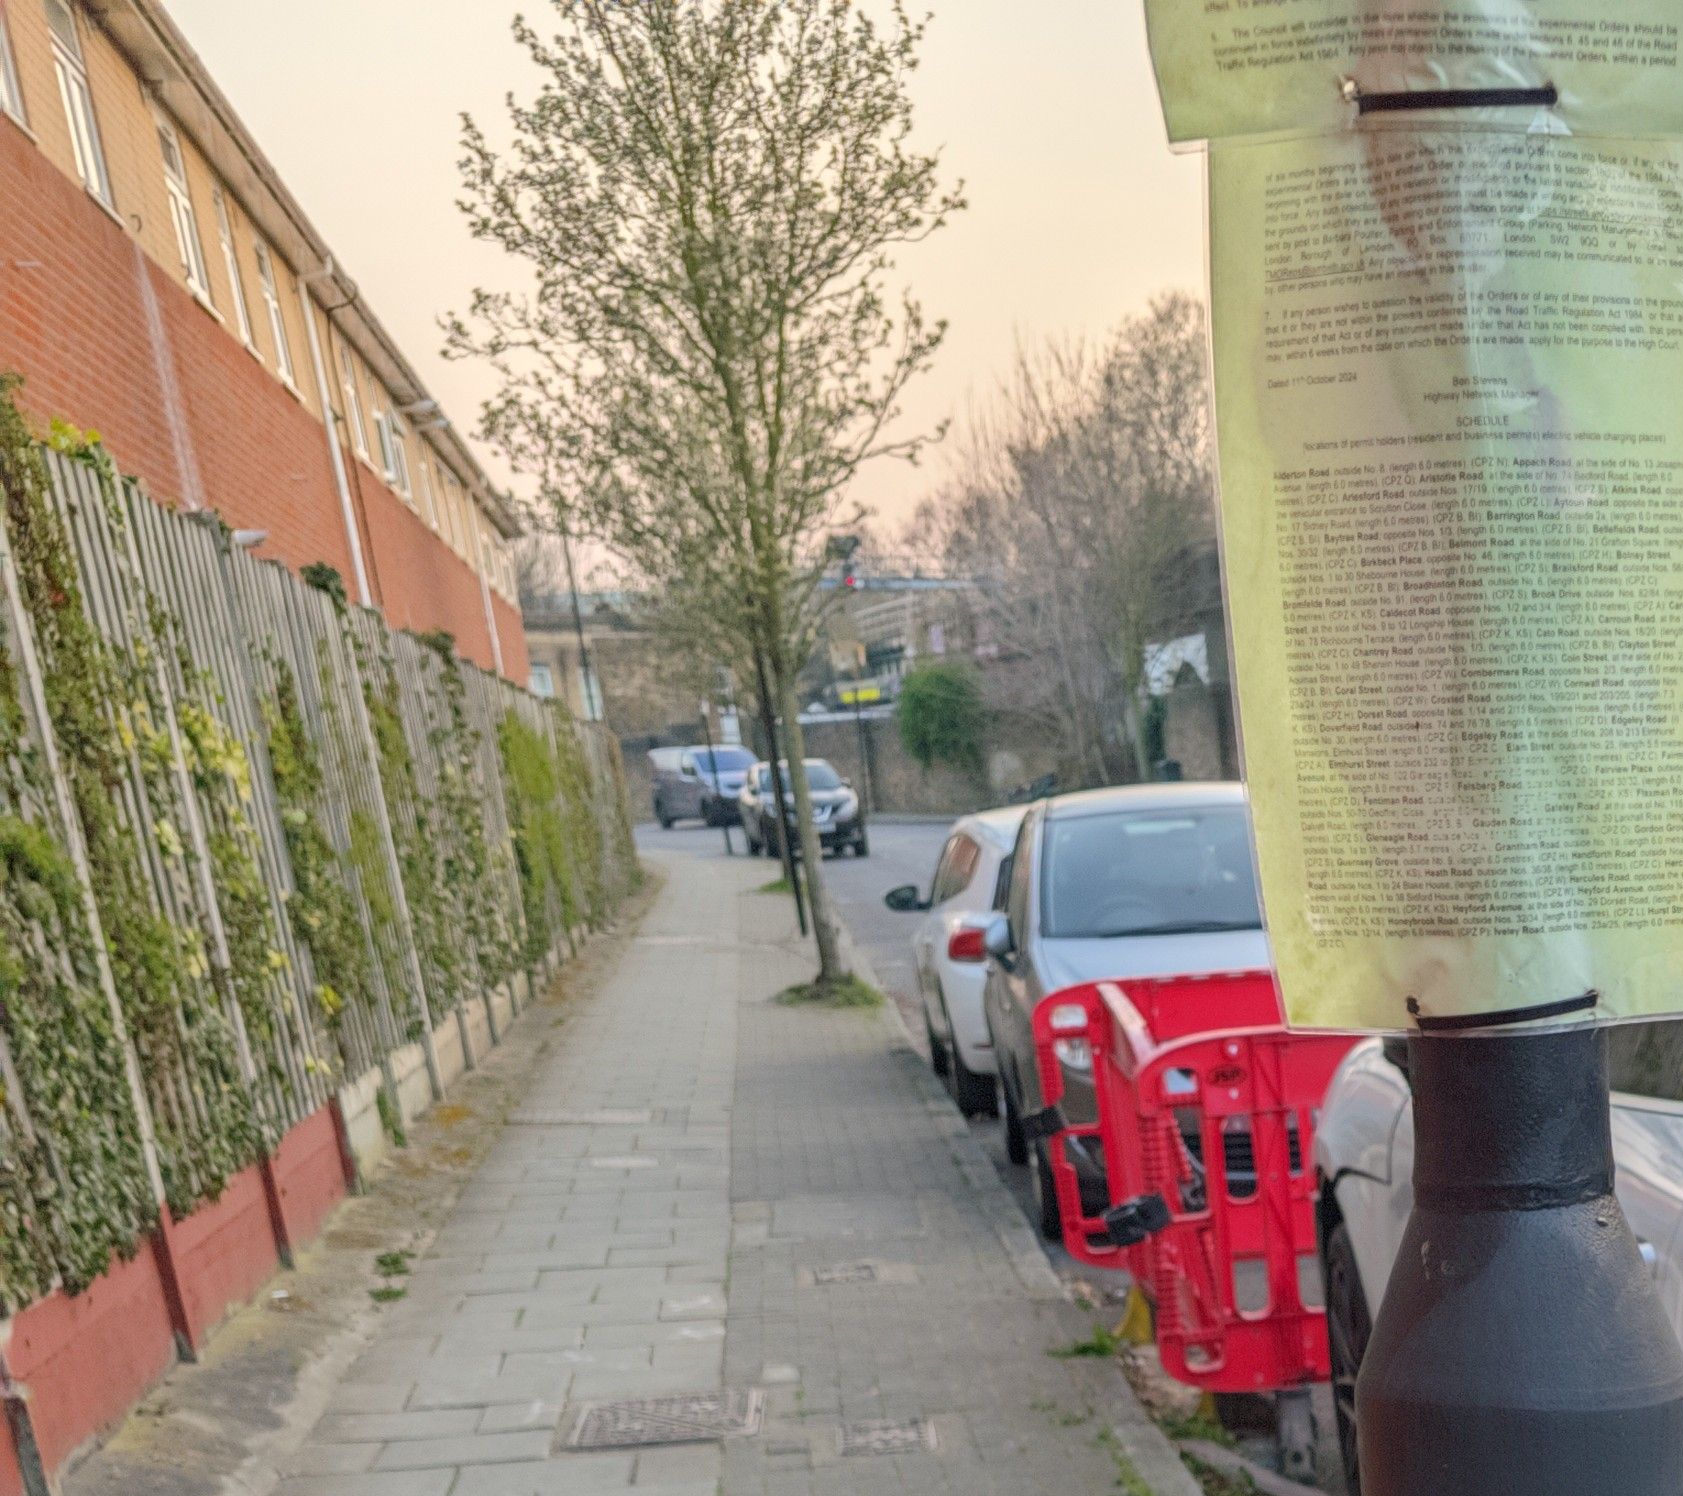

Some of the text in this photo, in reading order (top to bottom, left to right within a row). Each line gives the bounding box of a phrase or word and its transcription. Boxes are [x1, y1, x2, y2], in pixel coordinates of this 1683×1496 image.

[1600, 21, 1630, 32] Orders
[1654, 41, 1678, 50] Road
[1452, 376, 1470, 386] Ben
[1424, 392, 1460, 404] Highway
[1456, 416, 1509, 426] SCHEDULE
